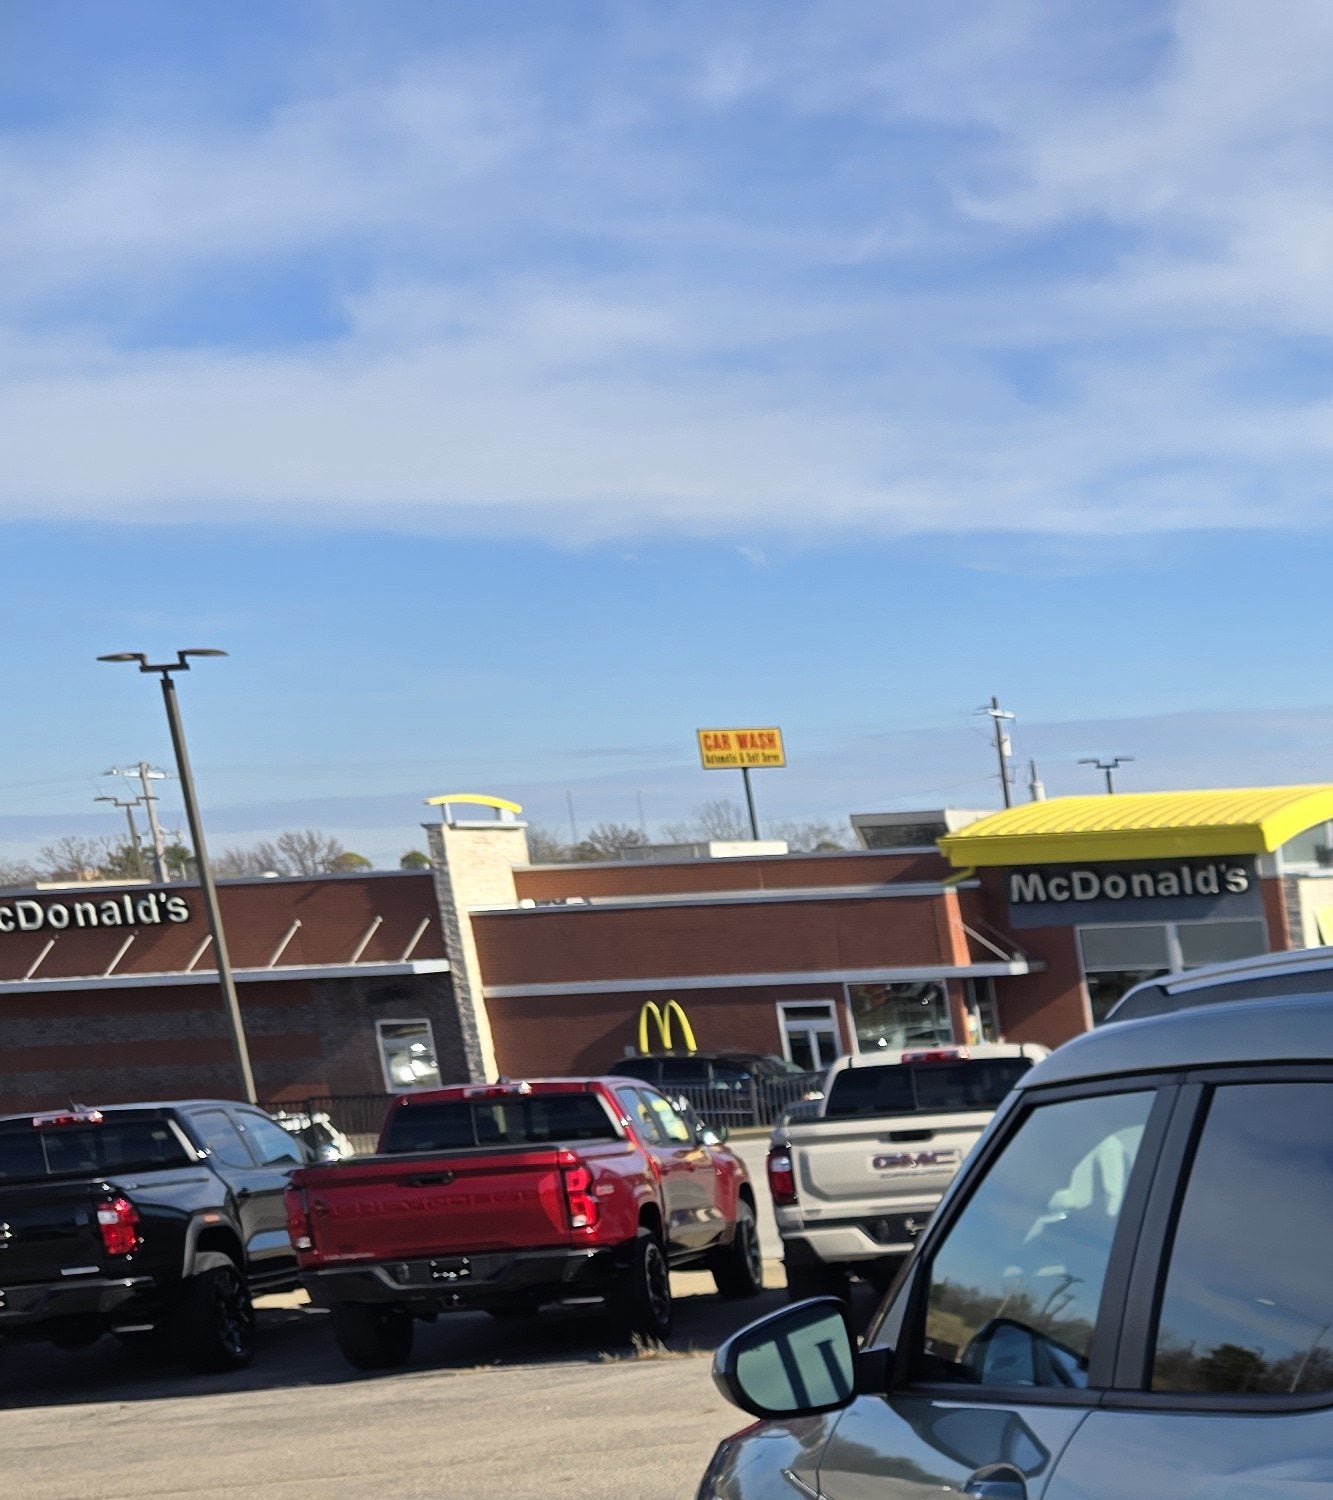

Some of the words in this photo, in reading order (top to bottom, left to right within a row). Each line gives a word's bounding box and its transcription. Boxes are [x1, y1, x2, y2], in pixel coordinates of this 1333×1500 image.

[703, 733, 732, 751] CAR
[736, 733, 777, 750] WASH
[1010, 862, 1249, 902] McDonald's
[0, 892, 189, 932] cDonald's
[873, 1150, 956, 1170] GMC
